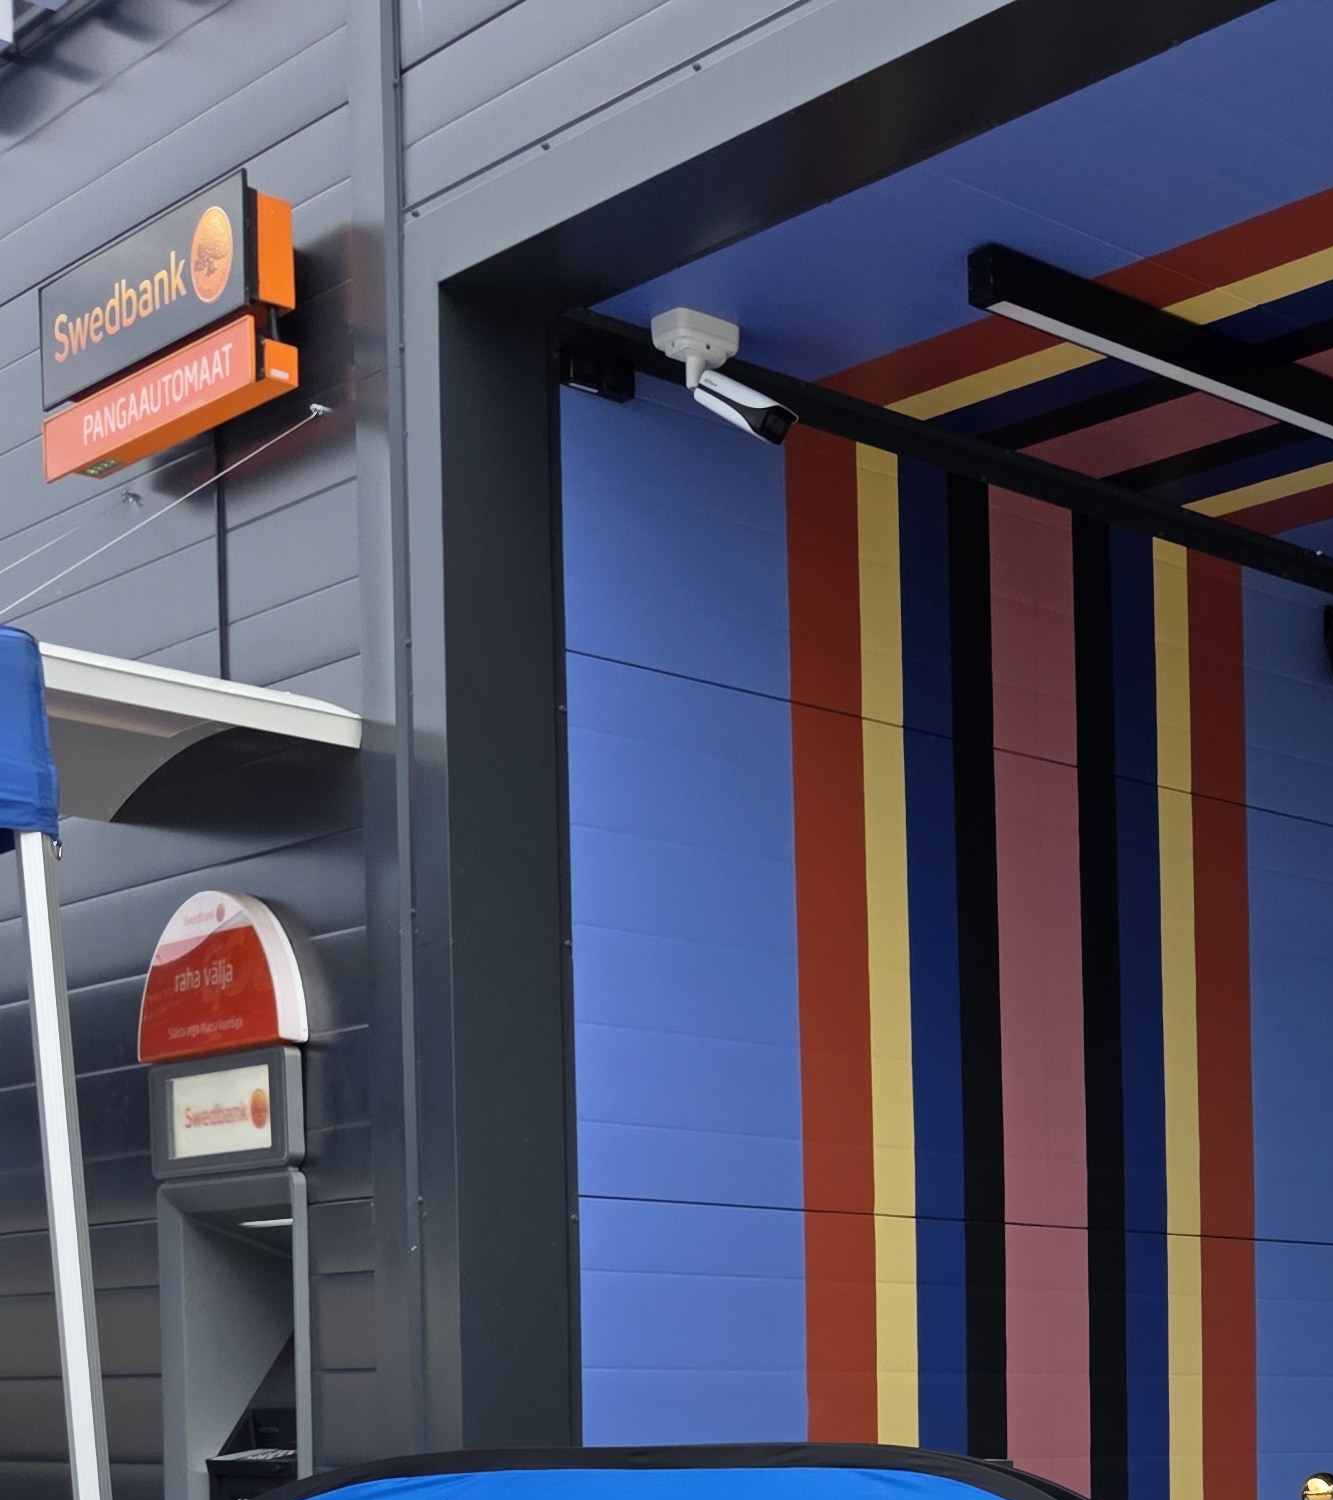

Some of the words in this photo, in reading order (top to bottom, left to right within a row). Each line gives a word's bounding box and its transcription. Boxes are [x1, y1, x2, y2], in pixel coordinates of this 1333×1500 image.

[54, 250, 187, 363] Swedbank
[82, 342, 233, 446] PANGAAUTOMAAT
[174, 966, 200, 992] raha
[203, 960, 233, 989] välja
[184, 1101, 248, 1129] Swedbank
